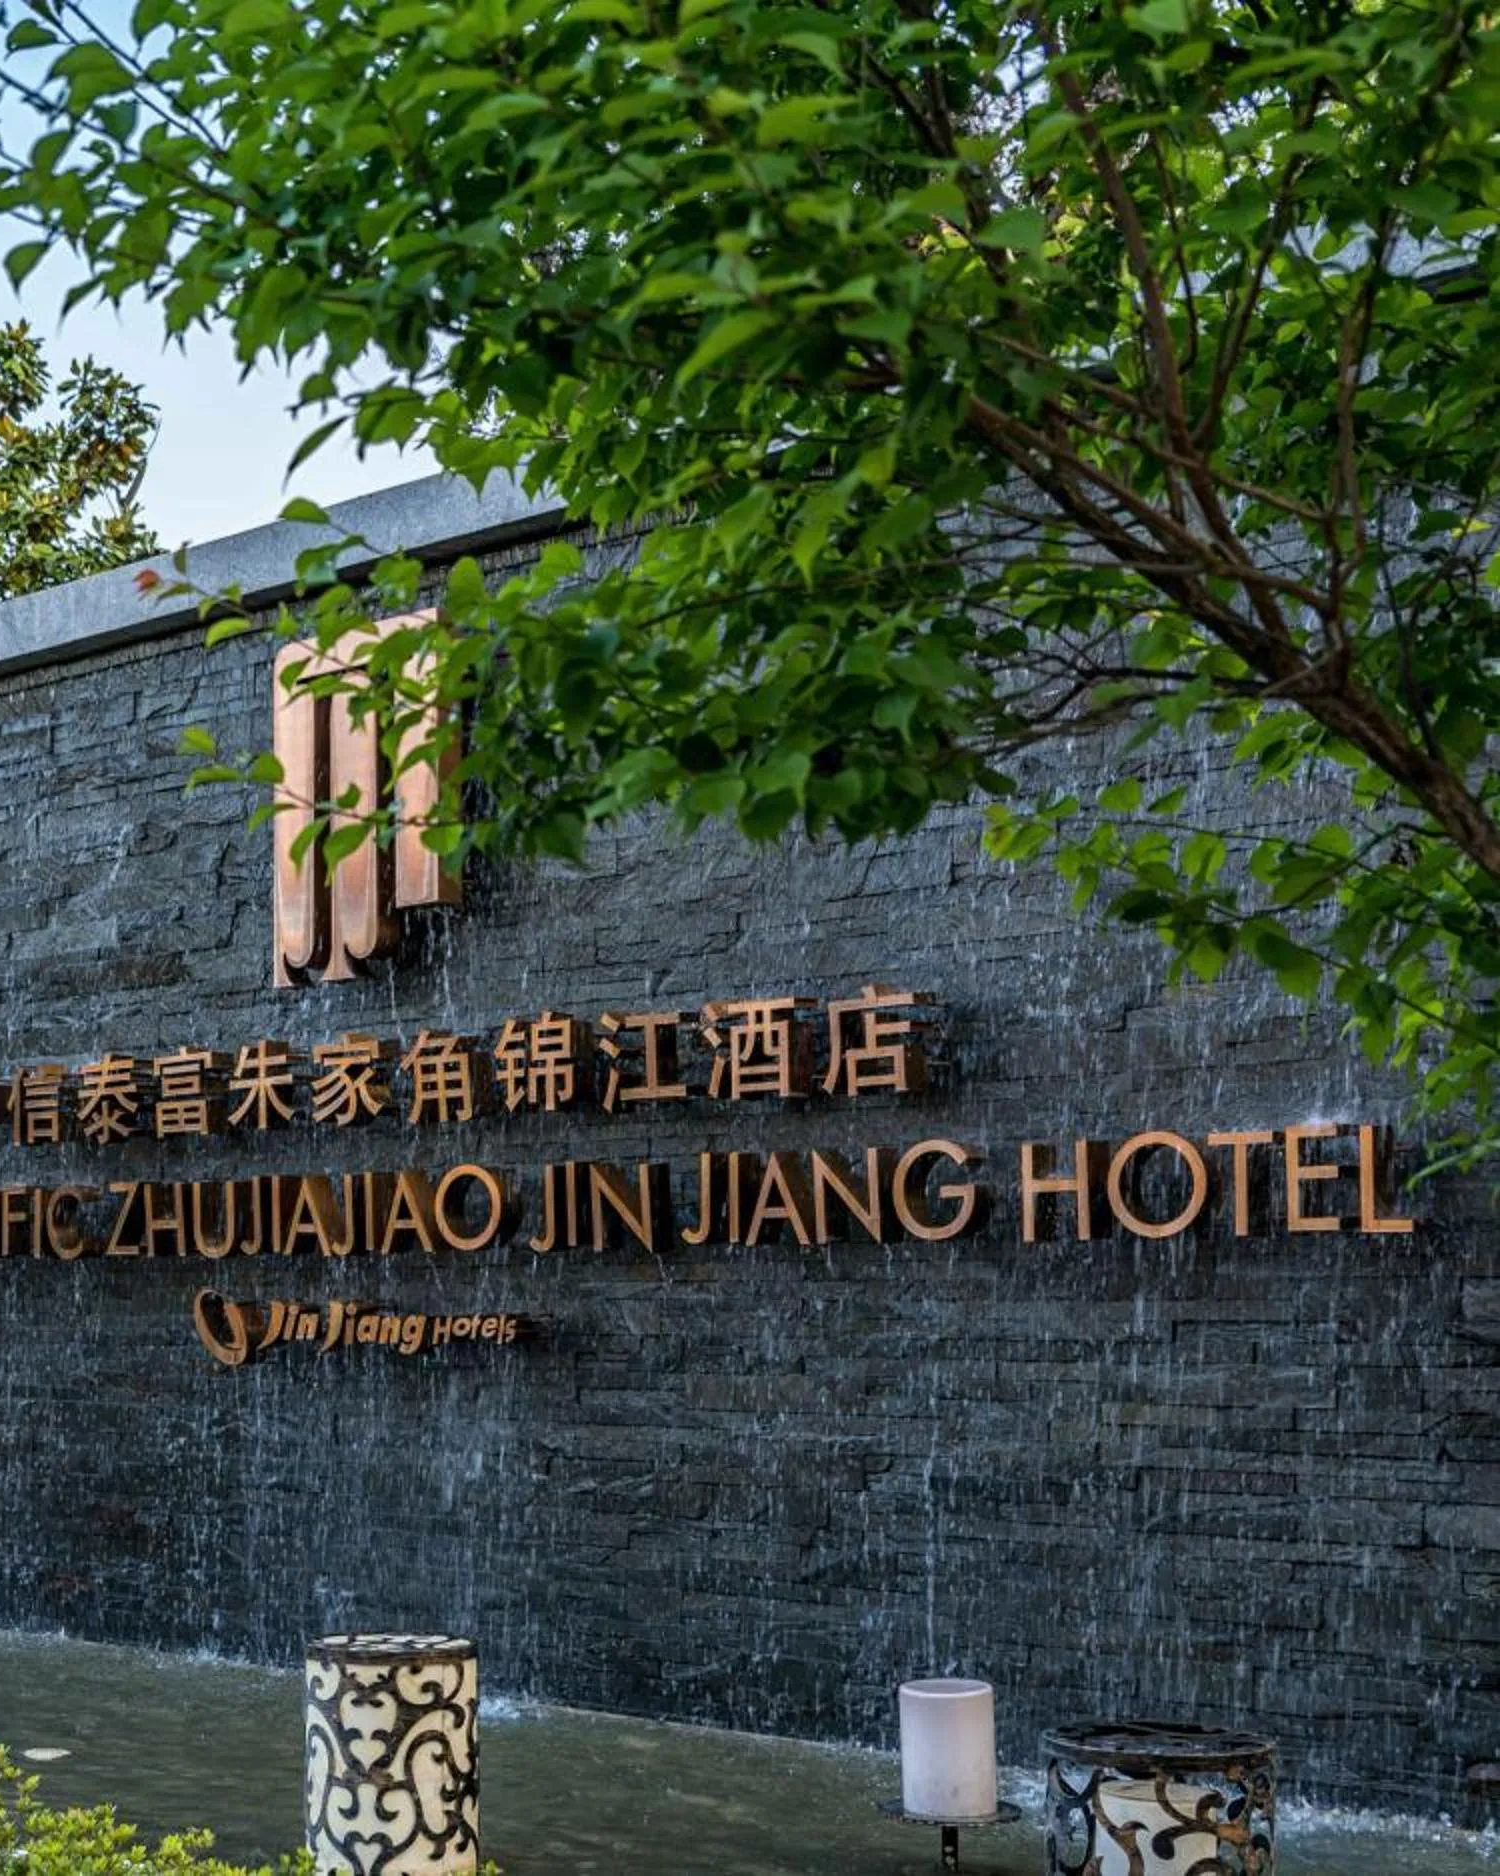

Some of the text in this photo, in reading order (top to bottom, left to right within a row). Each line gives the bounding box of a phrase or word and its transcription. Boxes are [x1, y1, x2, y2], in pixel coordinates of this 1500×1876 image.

[108, 1162, 504, 1260] ZHUJIAJIAO
[530, 1158, 654, 1254] JIN
[682, 1138, 977, 1248] JIANG
[1019, 1123, 1416, 1244] HOTEL
[320, 1301, 426, 1355] Jiang
